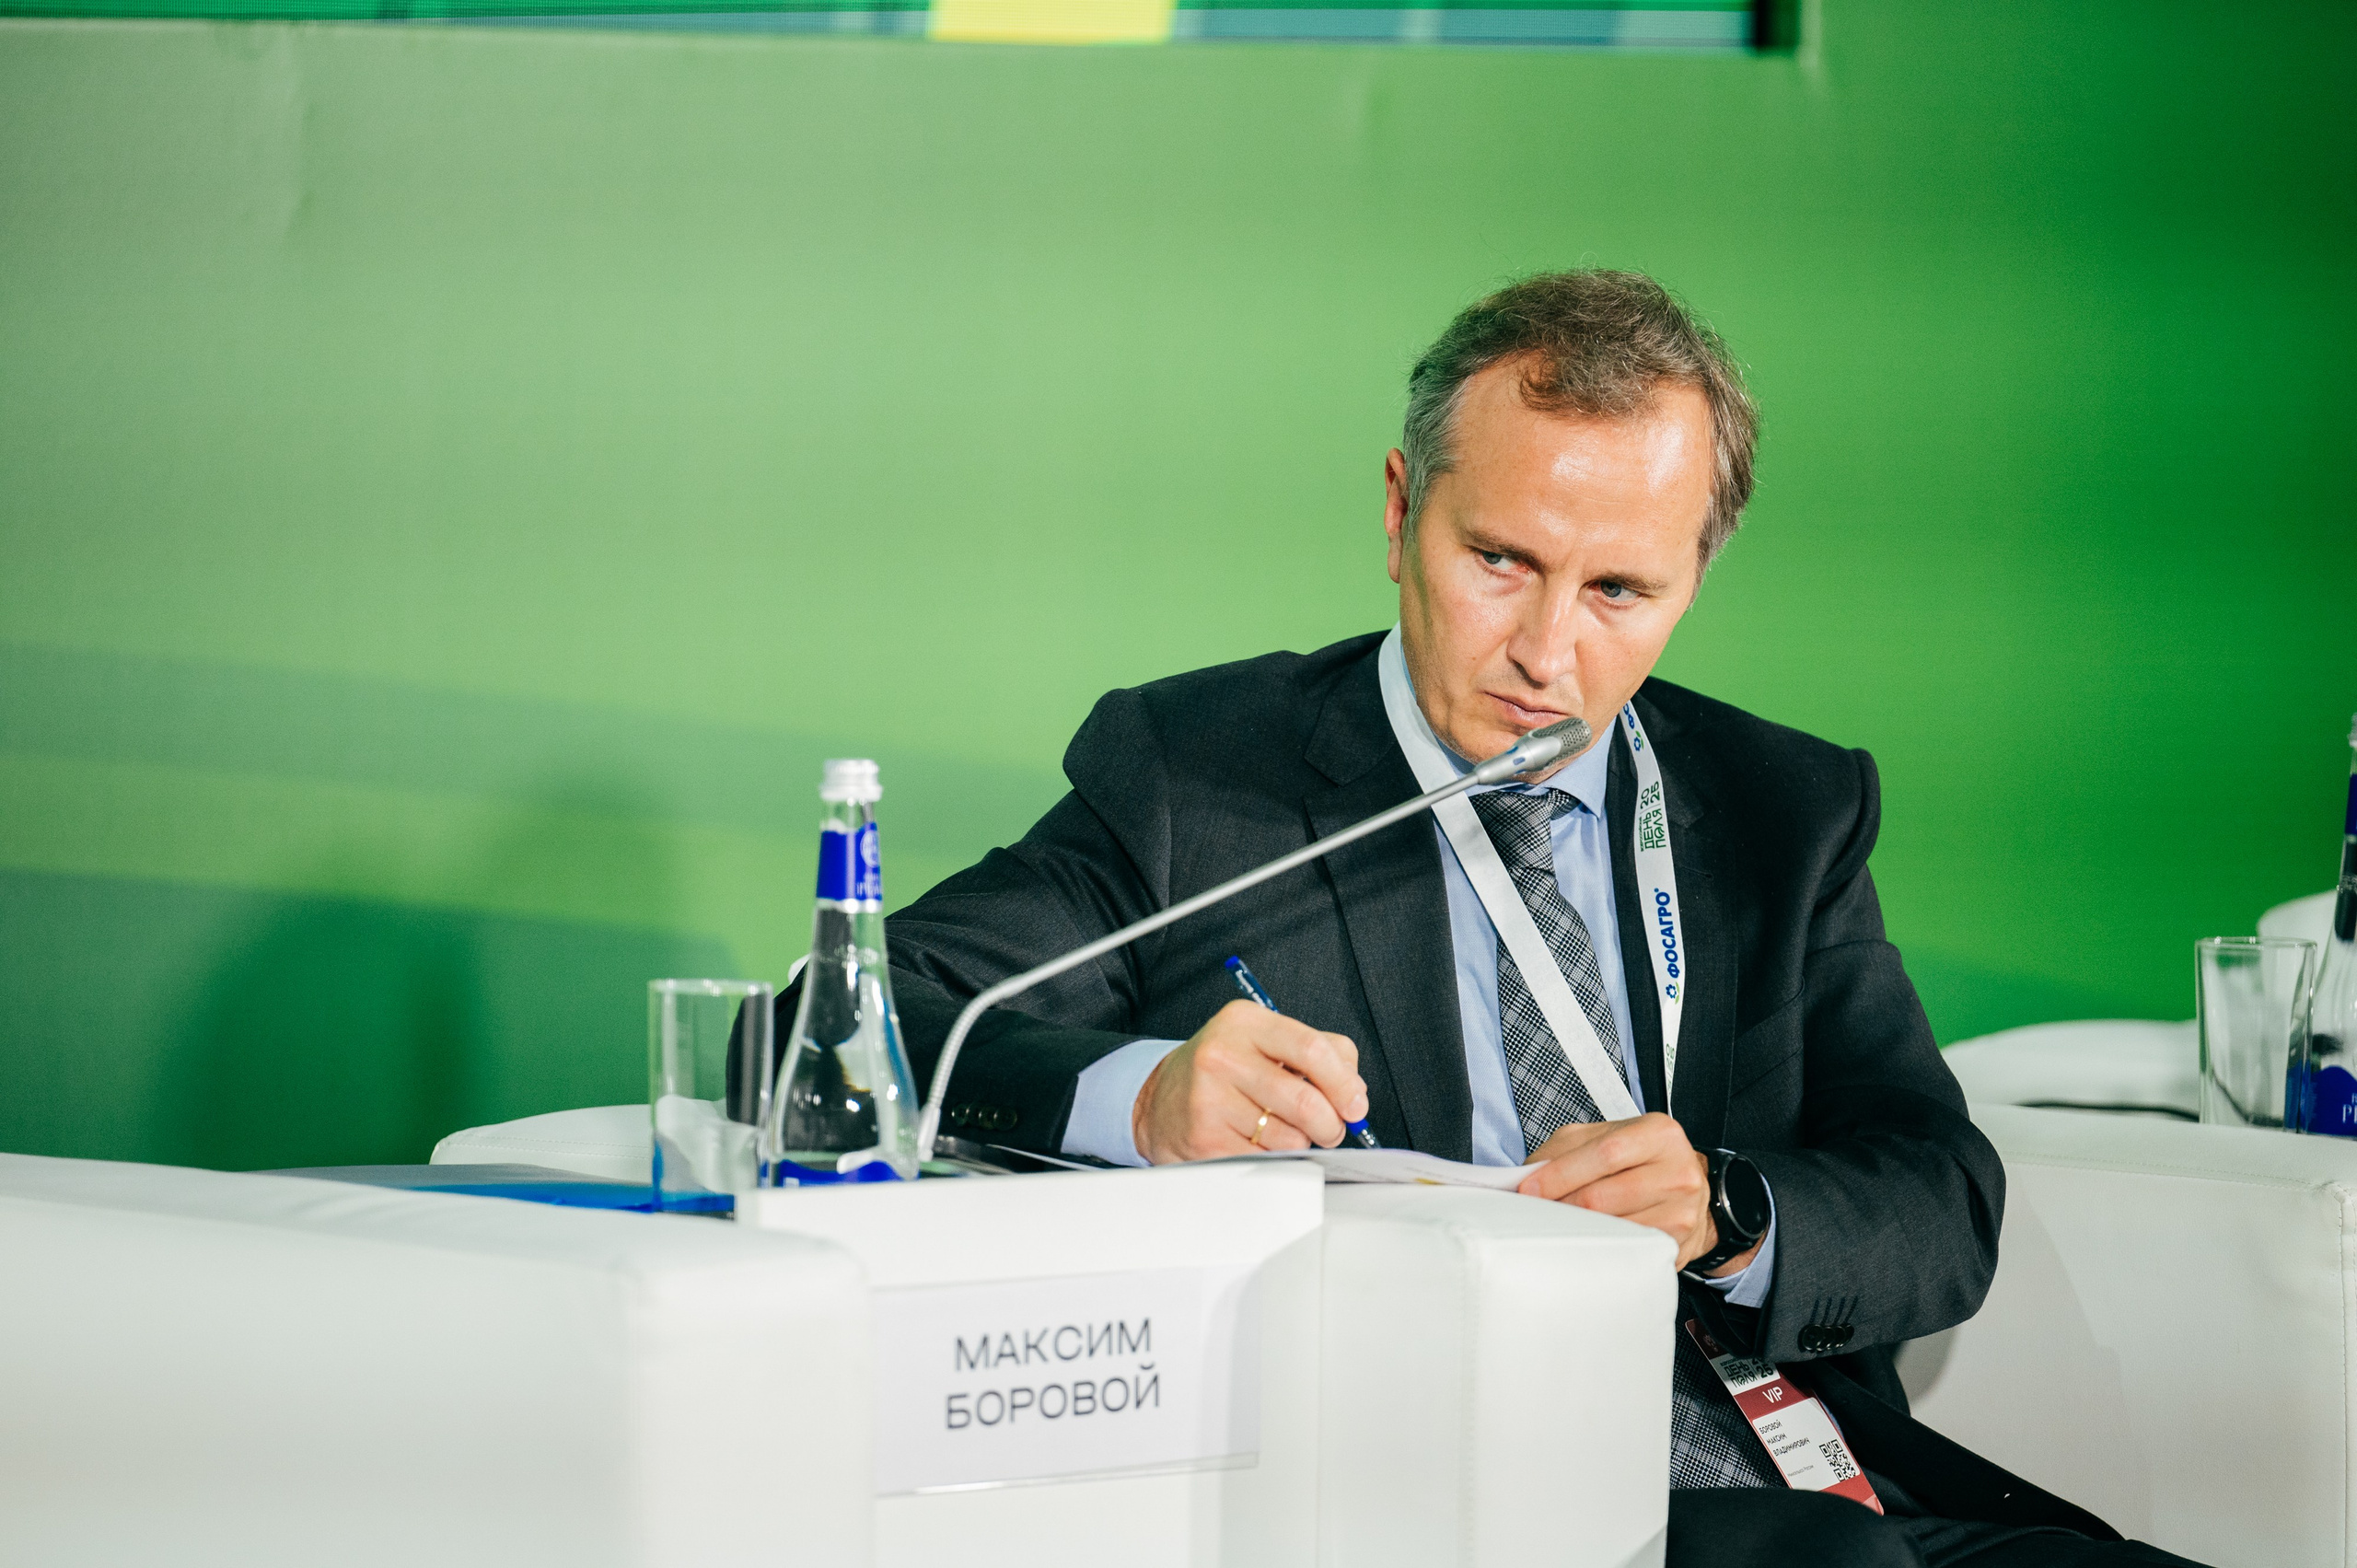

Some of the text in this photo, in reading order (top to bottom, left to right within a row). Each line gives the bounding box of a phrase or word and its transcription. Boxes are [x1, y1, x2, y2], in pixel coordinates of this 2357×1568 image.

[1640, 787, 1650, 809] 20
[1650, 781, 1661, 804] 25
[1643, 812, 1655, 849] ДЕНЬ
[1652, 808, 1666, 849] ПОЛЯ
[1655, 891, 1680, 979] ФОСАГРО
[954, 1317, 1152, 1372] МАКСИМ
[1724, 1361, 1750, 1378] ДЕНЬ
[1730, 1370, 1758, 1388] ПОЛЯ
[1756, 1363, 1774, 1378] 25
[946, 1361, 1160, 1430] БОРОВОЙ
[1761, 1386, 1783, 1403] VIP
[1759, 1419, 1782, 1434] БОРОВОЙ
[1766, 1433, 1788, 1446] МАКСИМ
[1772, 1436, 1811, 1457] ВЛАДИМИРОВИЧ
